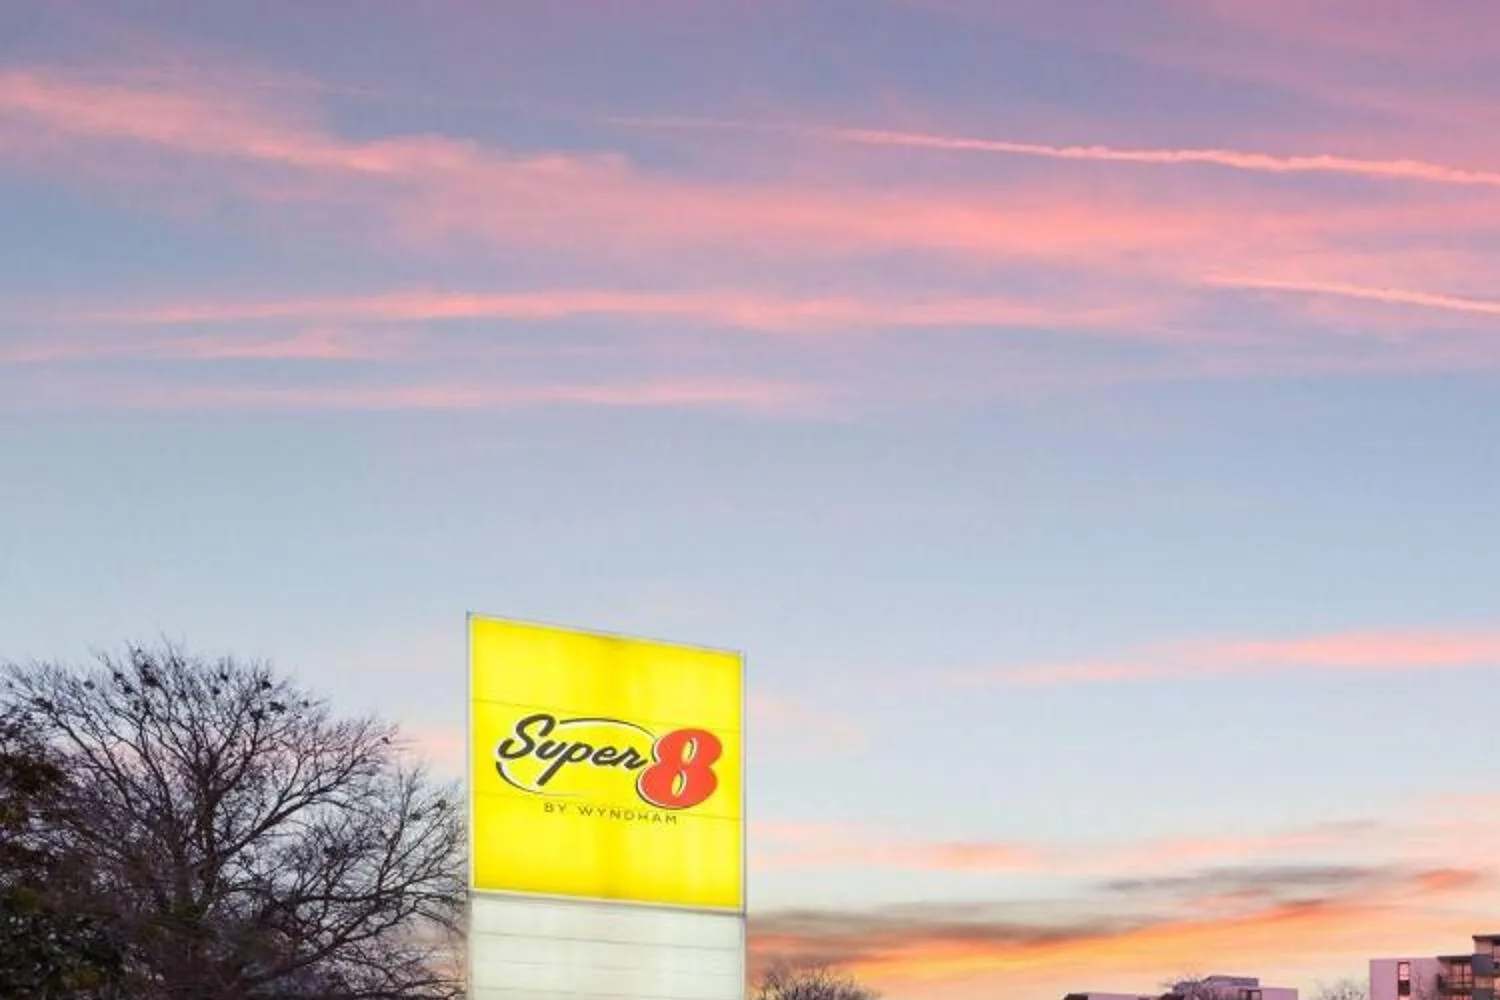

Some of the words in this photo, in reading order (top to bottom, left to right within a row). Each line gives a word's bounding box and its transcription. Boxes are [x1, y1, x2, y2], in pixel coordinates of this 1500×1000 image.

[497, 713, 648, 786] Super
[636, 728, 722, 809] 8
[543, 801, 567, 813] BY
[578, 804, 678, 825] WYNDHAM
